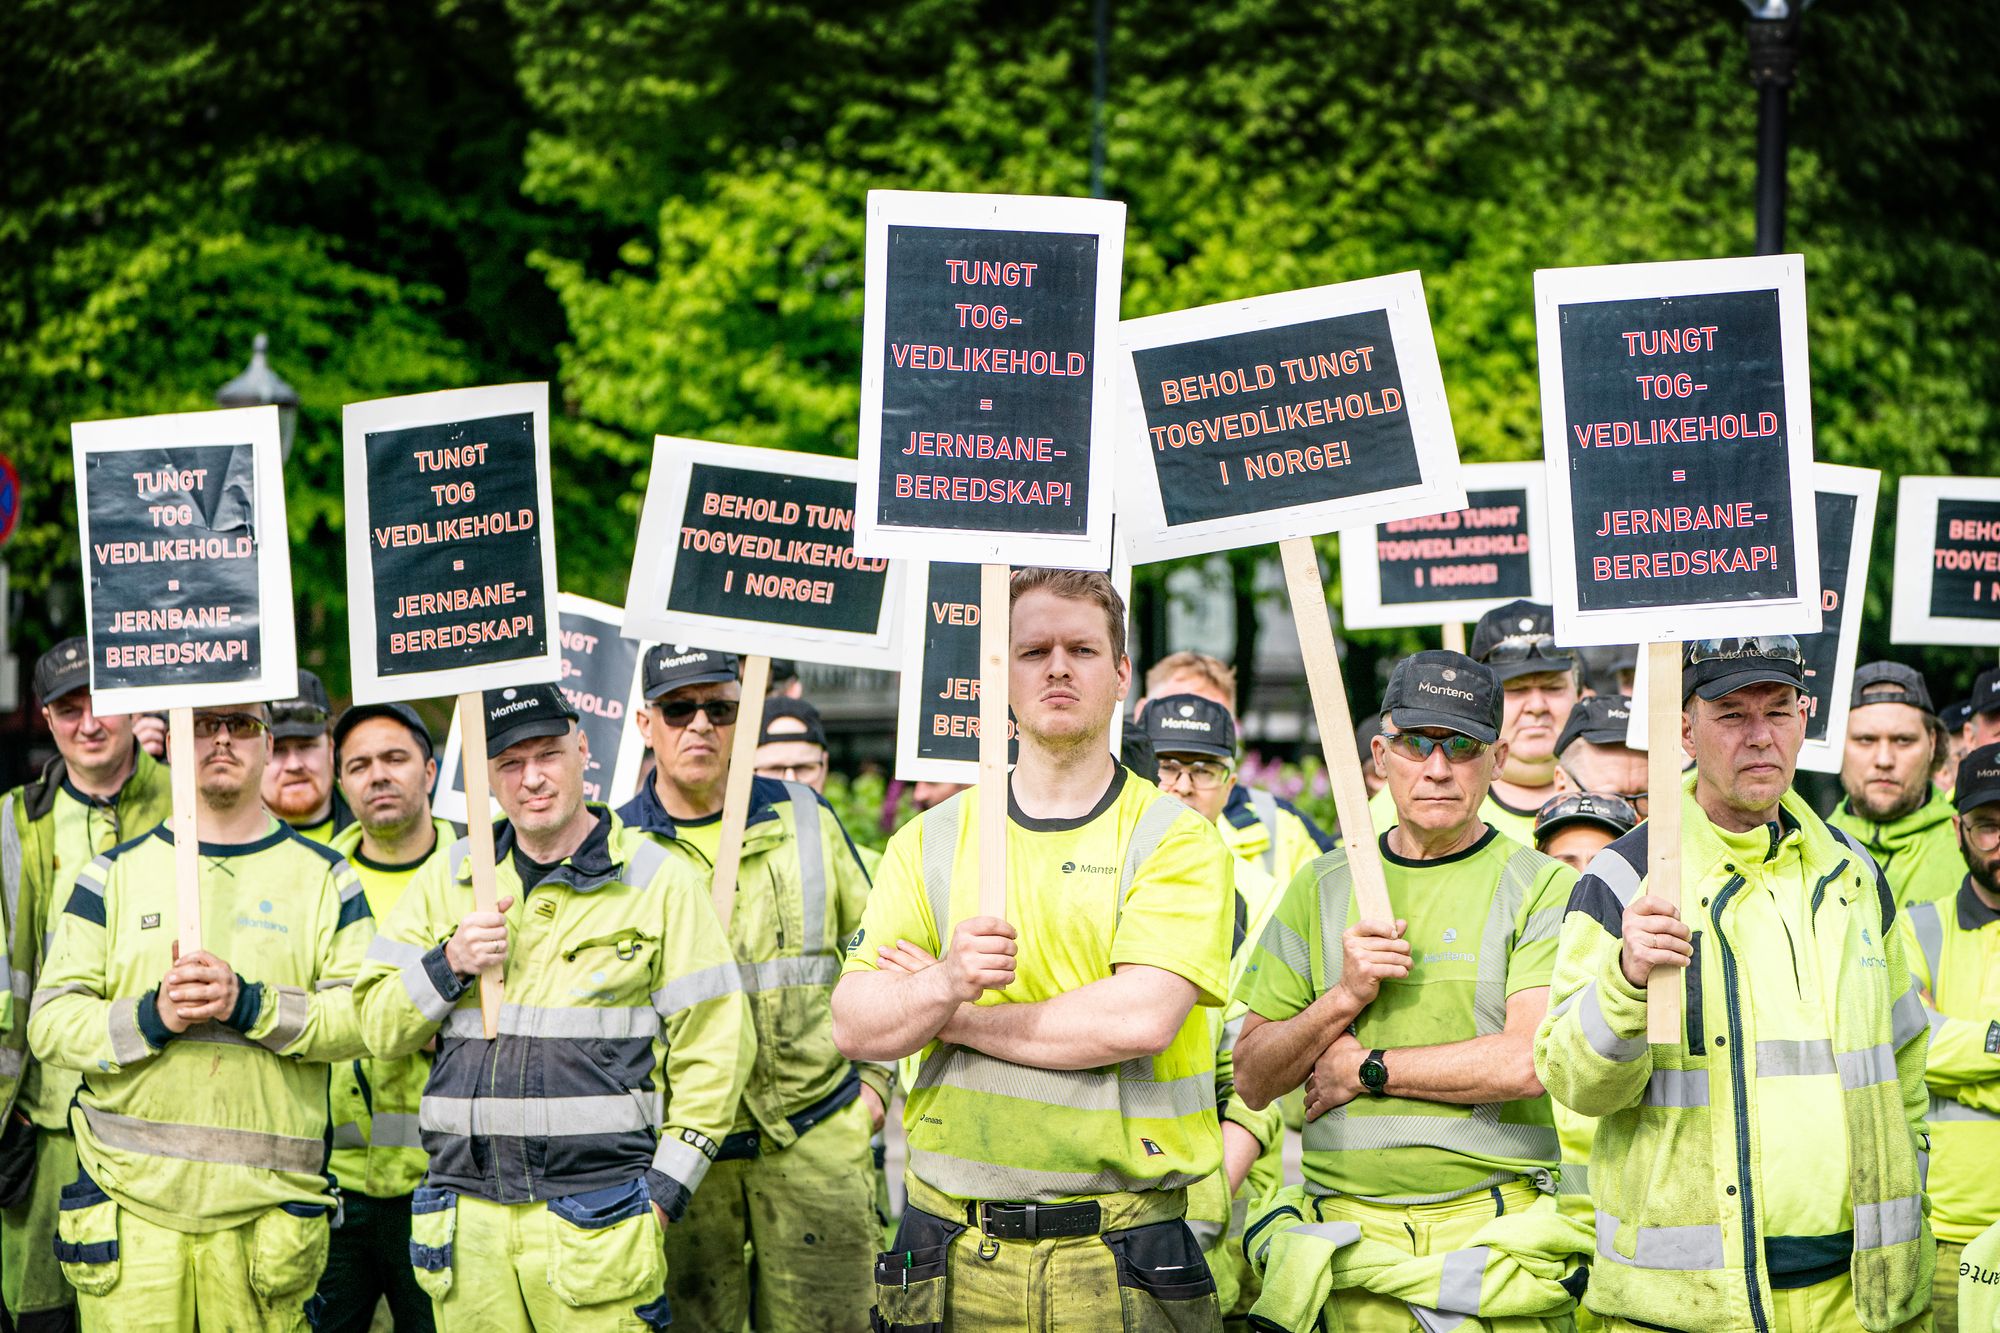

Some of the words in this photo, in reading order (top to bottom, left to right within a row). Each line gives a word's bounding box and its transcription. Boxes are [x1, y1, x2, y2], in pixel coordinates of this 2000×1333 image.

[946, 259, 1037, 287] TUNGT
[955, 303, 1022, 329] TOG-
[1622, 326, 1718, 357] TUNGT
[891, 344, 1086, 377] VEDLIKEHOLD
[1161, 364, 1275, 406] BEHOLD
[1280, 346, 1374, 385] TUNGT
[1636, 373, 1708, 401] TOG-
[980, 398, 993, 411] =
[1150, 388, 1403, 451] TOGVEDLIKEHOLD
[1574, 412, 1778, 449] VEDLIKEHOLD
[414, 443, 488, 473] TUNGT
[902, 431, 1067, 462] JERNBANE-
[1220, 461, 1230, 485] I
[1244, 441, 1352, 482] NORGE!
[1673, 470, 1686, 482] =
[133, 469, 207, 494] TUNGT
[431, 481, 475, 506] TOG
[895, 474, 1072, 506] BEREDSKAP!
[148, 504, 192, 527] TOG
[703, 492, 800, 525] BEHOLD
[805, 505, 856, 532] TUN
[1461, 506, 1520, 529] TUNGT
[1596, 502, 1768, 537] JERNBANE-
[375, 509, 534, 549] VEDLIKEHOLD
[94, 537, 253, 565] VEDLIKEHOLD
[1377, 533, 1529, 562] TOGVEDLIKEHOLD
[1935, 548, 2000, 571] TOGVE
[453, 560, 464, 571] =
[1414, 567, 1424, 588] I
[1430, 563, 1498, 587] NORGE!
[1593, 546, 1778, 581] BEREDSKAP!
[393, 582, 527, 619] JERNBANE-
[724, 570, 733, 592] I
[745, 573, 834, 604] NORGE!
[1973, 580, 1981, 601] I
[109, 606, 242, 633] JERNBANE-
[390, 615, 533, 654] BEREDSKAP!
[106, 640, 248, 668] BEREDSKAP!
[660, 652, 708, 670] Mantena
[1418, 681, 1474, 701] Mantena
[490, 698, 539, 720] Mantena
[1161, 717, 1211, 731] Mantena
